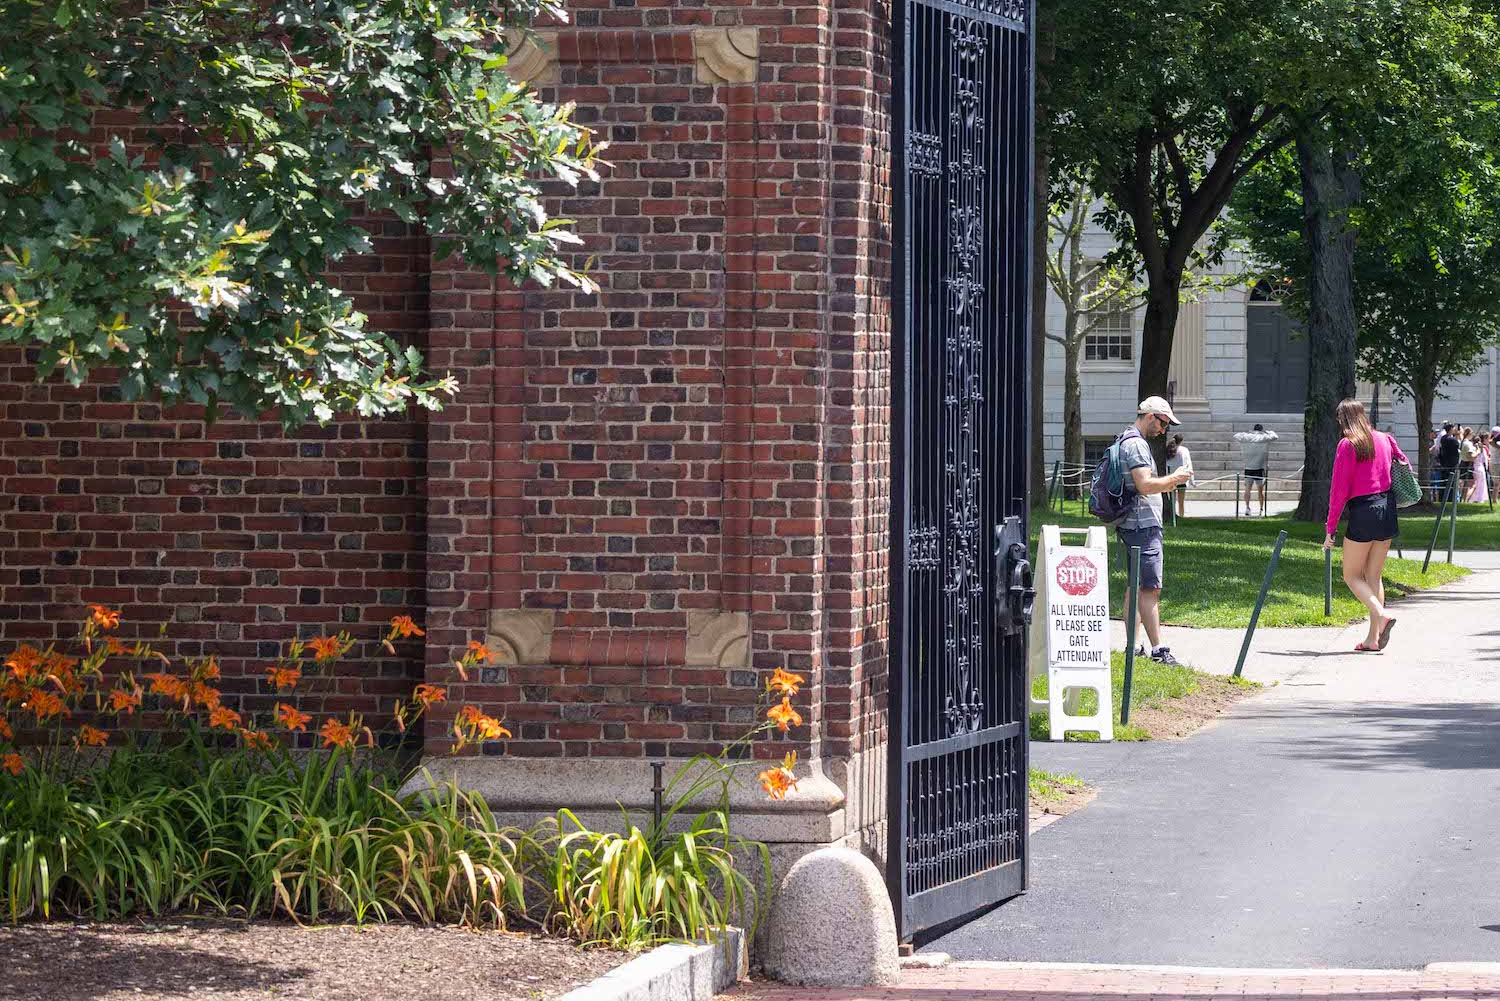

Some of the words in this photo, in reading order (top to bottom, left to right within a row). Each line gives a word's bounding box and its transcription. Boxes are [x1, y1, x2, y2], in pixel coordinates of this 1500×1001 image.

[1058, 566, 1096, 585] STOP
[1051, 604, 1066, 616] ALL
[1068, 604, 1106, 617] VEHICLES
[1056, 620, 1085, 632] PLEASE
[1087, 620, 1102, 632] SEE
[1069, 635, 1089, 647] GATE
[1057, 650, 1103, 662] ATTENDANT
